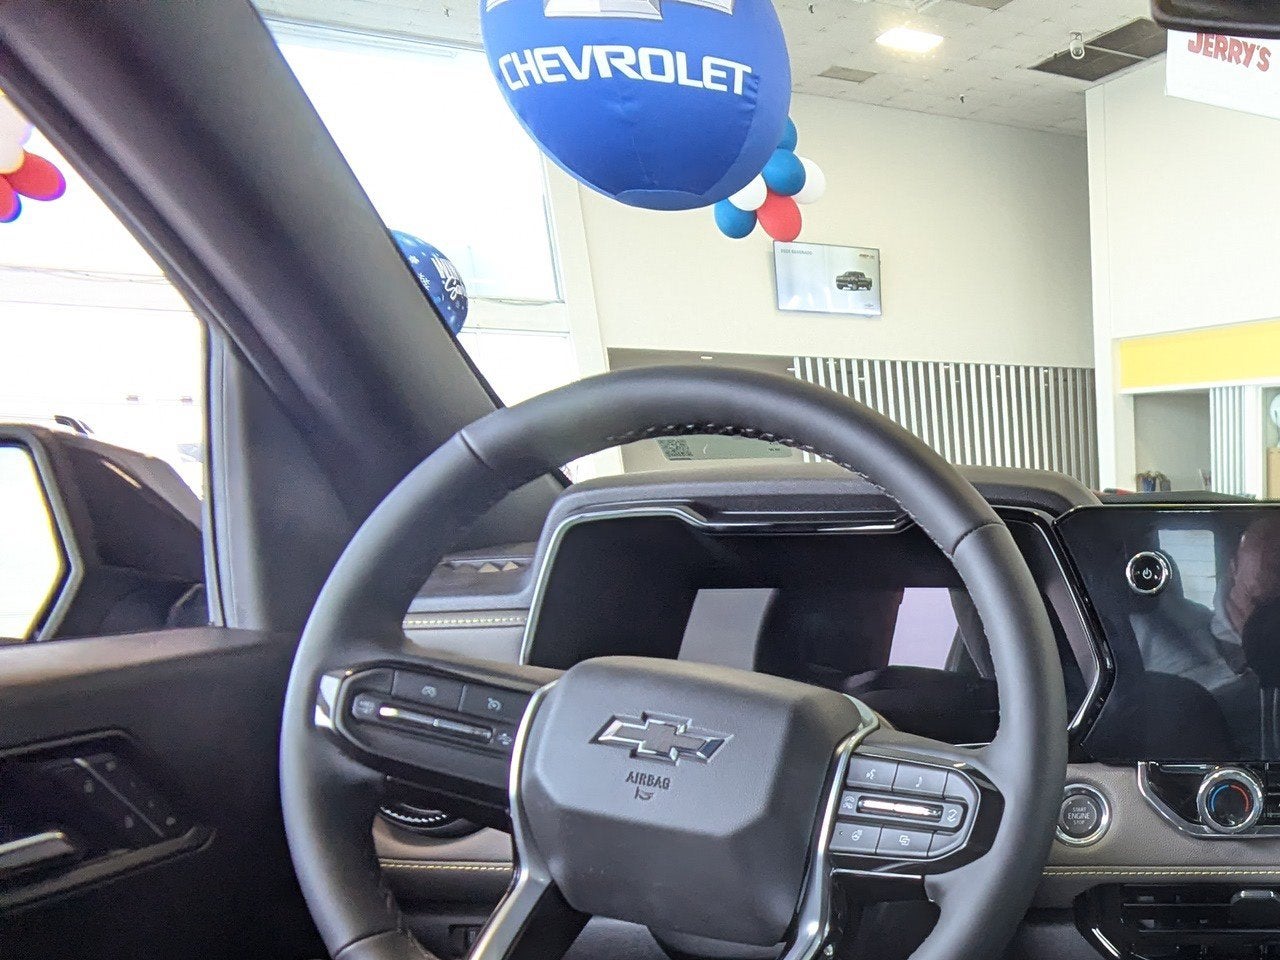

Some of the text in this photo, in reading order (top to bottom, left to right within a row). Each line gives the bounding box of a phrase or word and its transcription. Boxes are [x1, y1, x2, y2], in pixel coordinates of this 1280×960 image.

[1188, 33, 1271, 72] JERRY'S
[499, 45, 751, 95] CHEVROLET
[625, 771, 671, 790] AIRBAG
[1068, 812, 1090, 820] ENGINE
